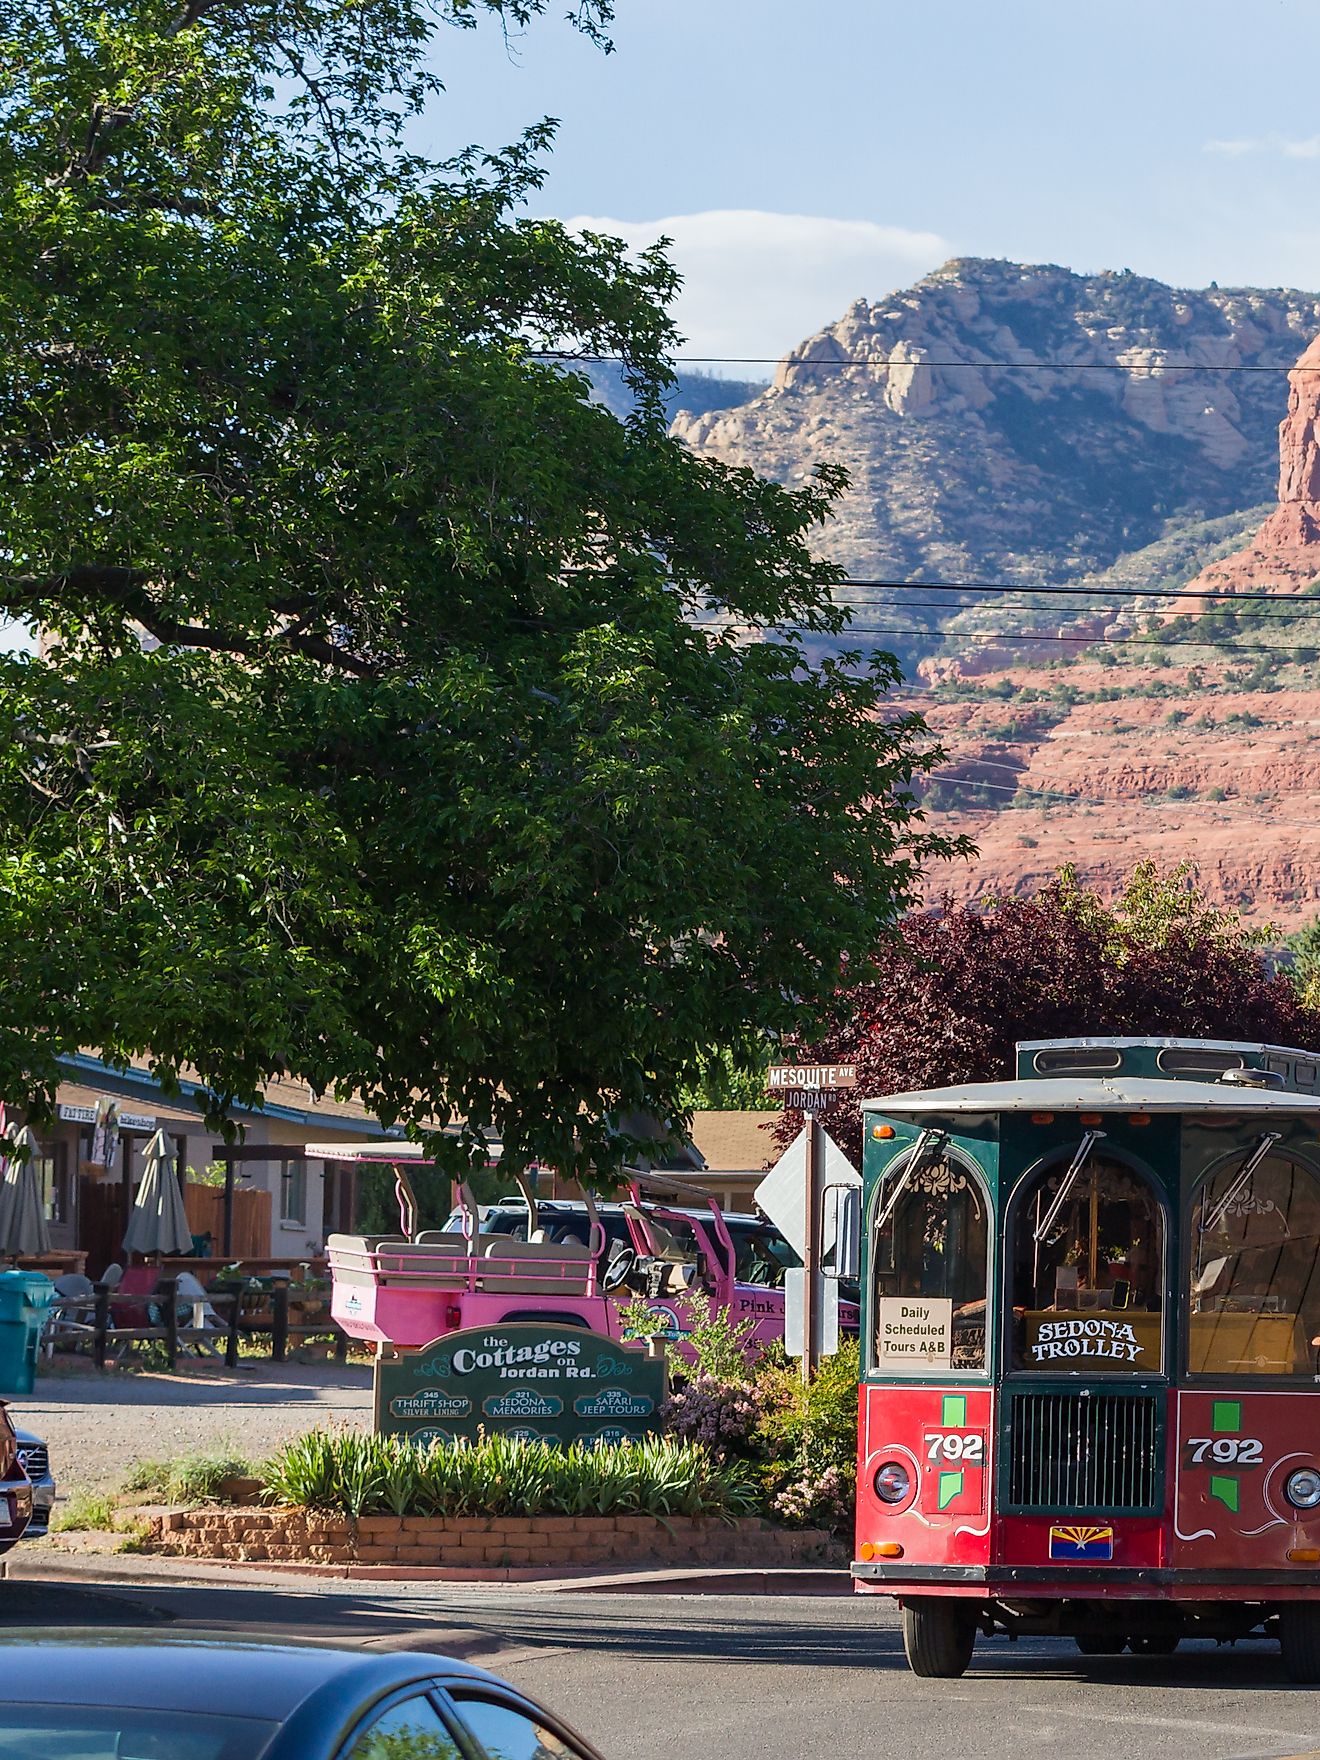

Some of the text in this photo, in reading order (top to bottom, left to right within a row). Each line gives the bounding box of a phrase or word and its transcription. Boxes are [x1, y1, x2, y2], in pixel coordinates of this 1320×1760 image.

[770, 1067, 854, 1086] MESQUITE AVE
[786, 1091, 837, 1109] JORDAN RD
[63, 1107, 96, 1121] FAT TIRE
[740, 1300, 775, 1314] Pink
[901, 1306, 930, 1321] Daily
[885, 1323, 945, 1335] Scheduled
[1038, 1319, 1138, 1343] SEDONA
[483, 1336, 508, 1347] the
[884, 1340, 945, 1353] Tours A&B
[1031, 1338, 1145, 1362] TROLLEY
[453, 1339, 581, 1374] Cottages
[556, 1356, 576, 1367] on
[499, 1367, 597, 1379] Jordan Rd.
[423, 1391, 439, 1399] 345
[515, 1391, 530, 1399] 321
[606, 1391, 622, 1399] 335
[397, 1399, 469, 1409] THRIFT SHOP
[500, 1398, 546, 1406] SEDONA
[596, 1397, 632, 1406] SAFARI
[403, 1408, 459, 1416] SILVER LINING
[492, 1405, 553, 1415] MEMORIES
[582, 1405, 646, 1414] JEEP TOURS
[924, 1434, 983, 1460] 792
[1187, 1438, 1264, 1464] 792
